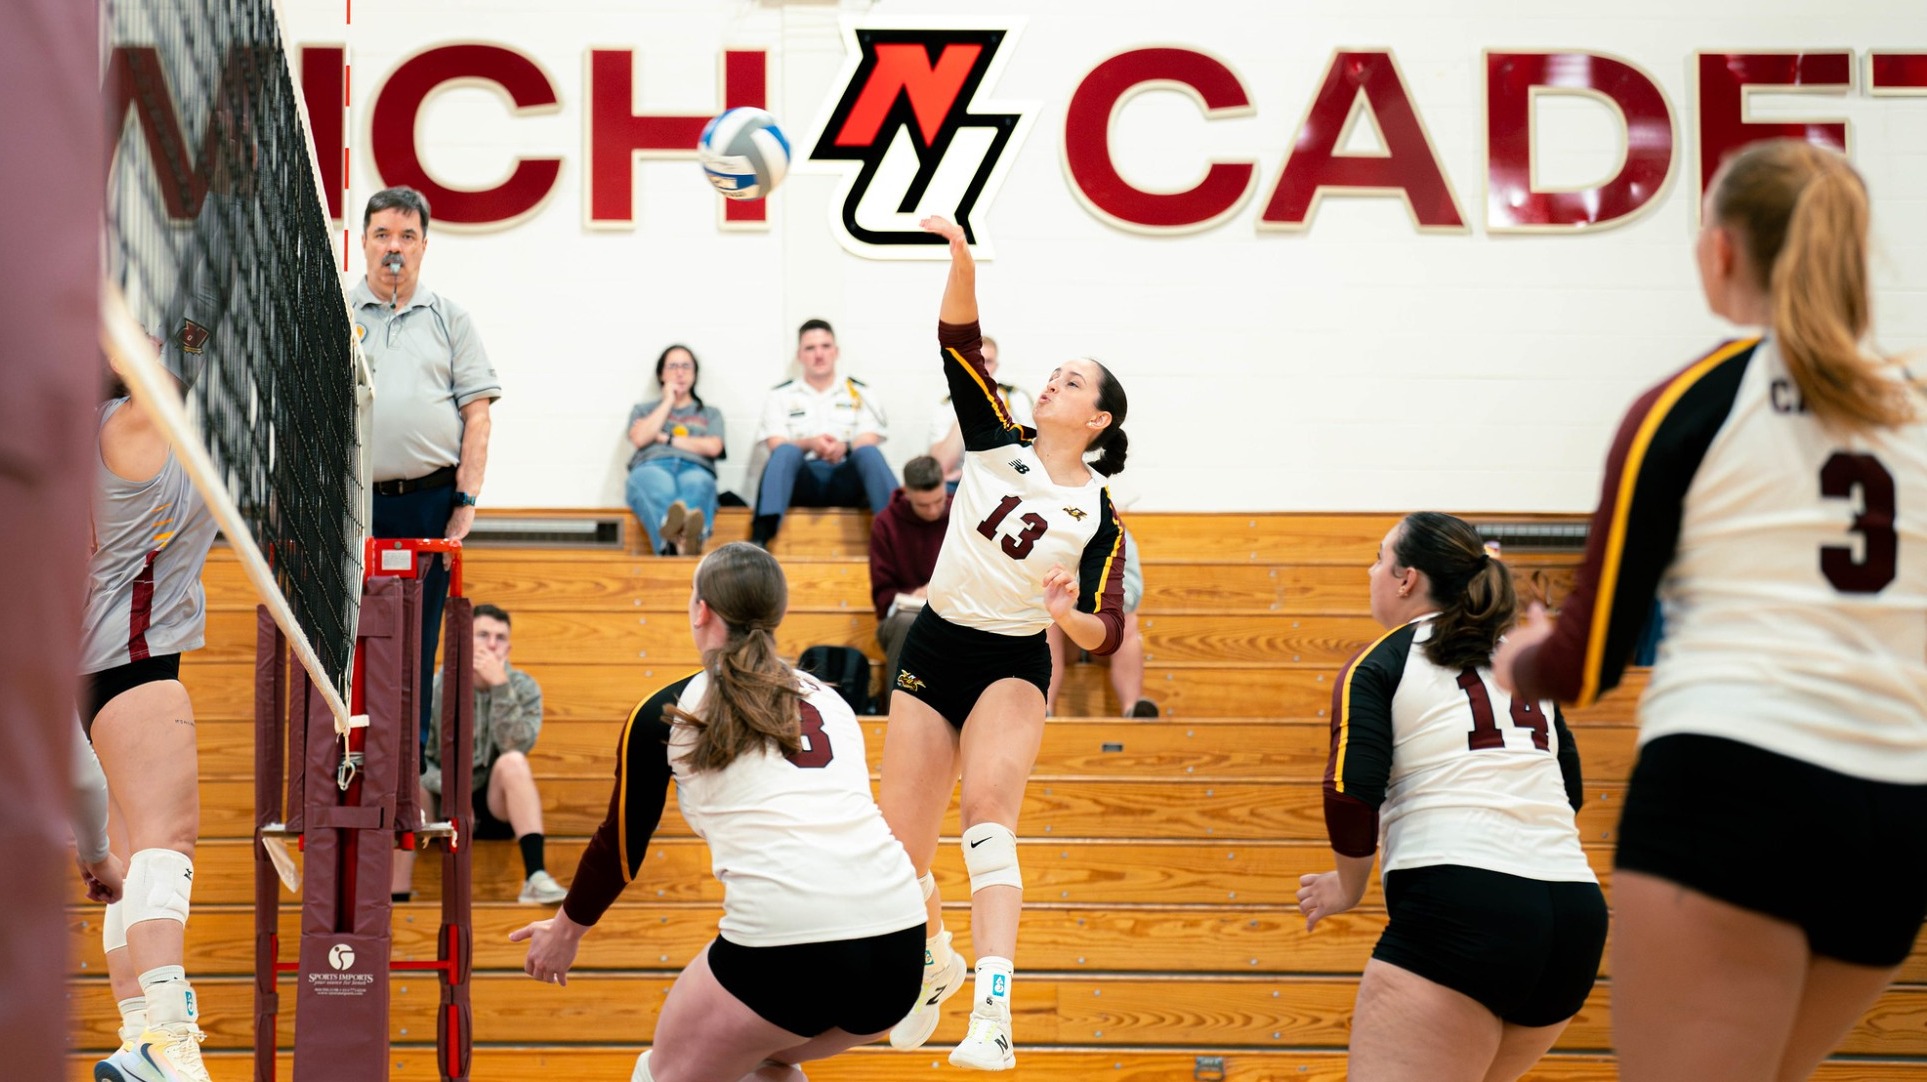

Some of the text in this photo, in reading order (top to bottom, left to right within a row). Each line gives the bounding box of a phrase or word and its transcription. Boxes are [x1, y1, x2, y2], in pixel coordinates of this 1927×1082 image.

[976, 494, 1048, 560] 13
[1820, 452, 1898, 594] 3
[1456, 665, 1551, 752] 14
[308, 973, 374, 984] SPORTS IMPORTS
